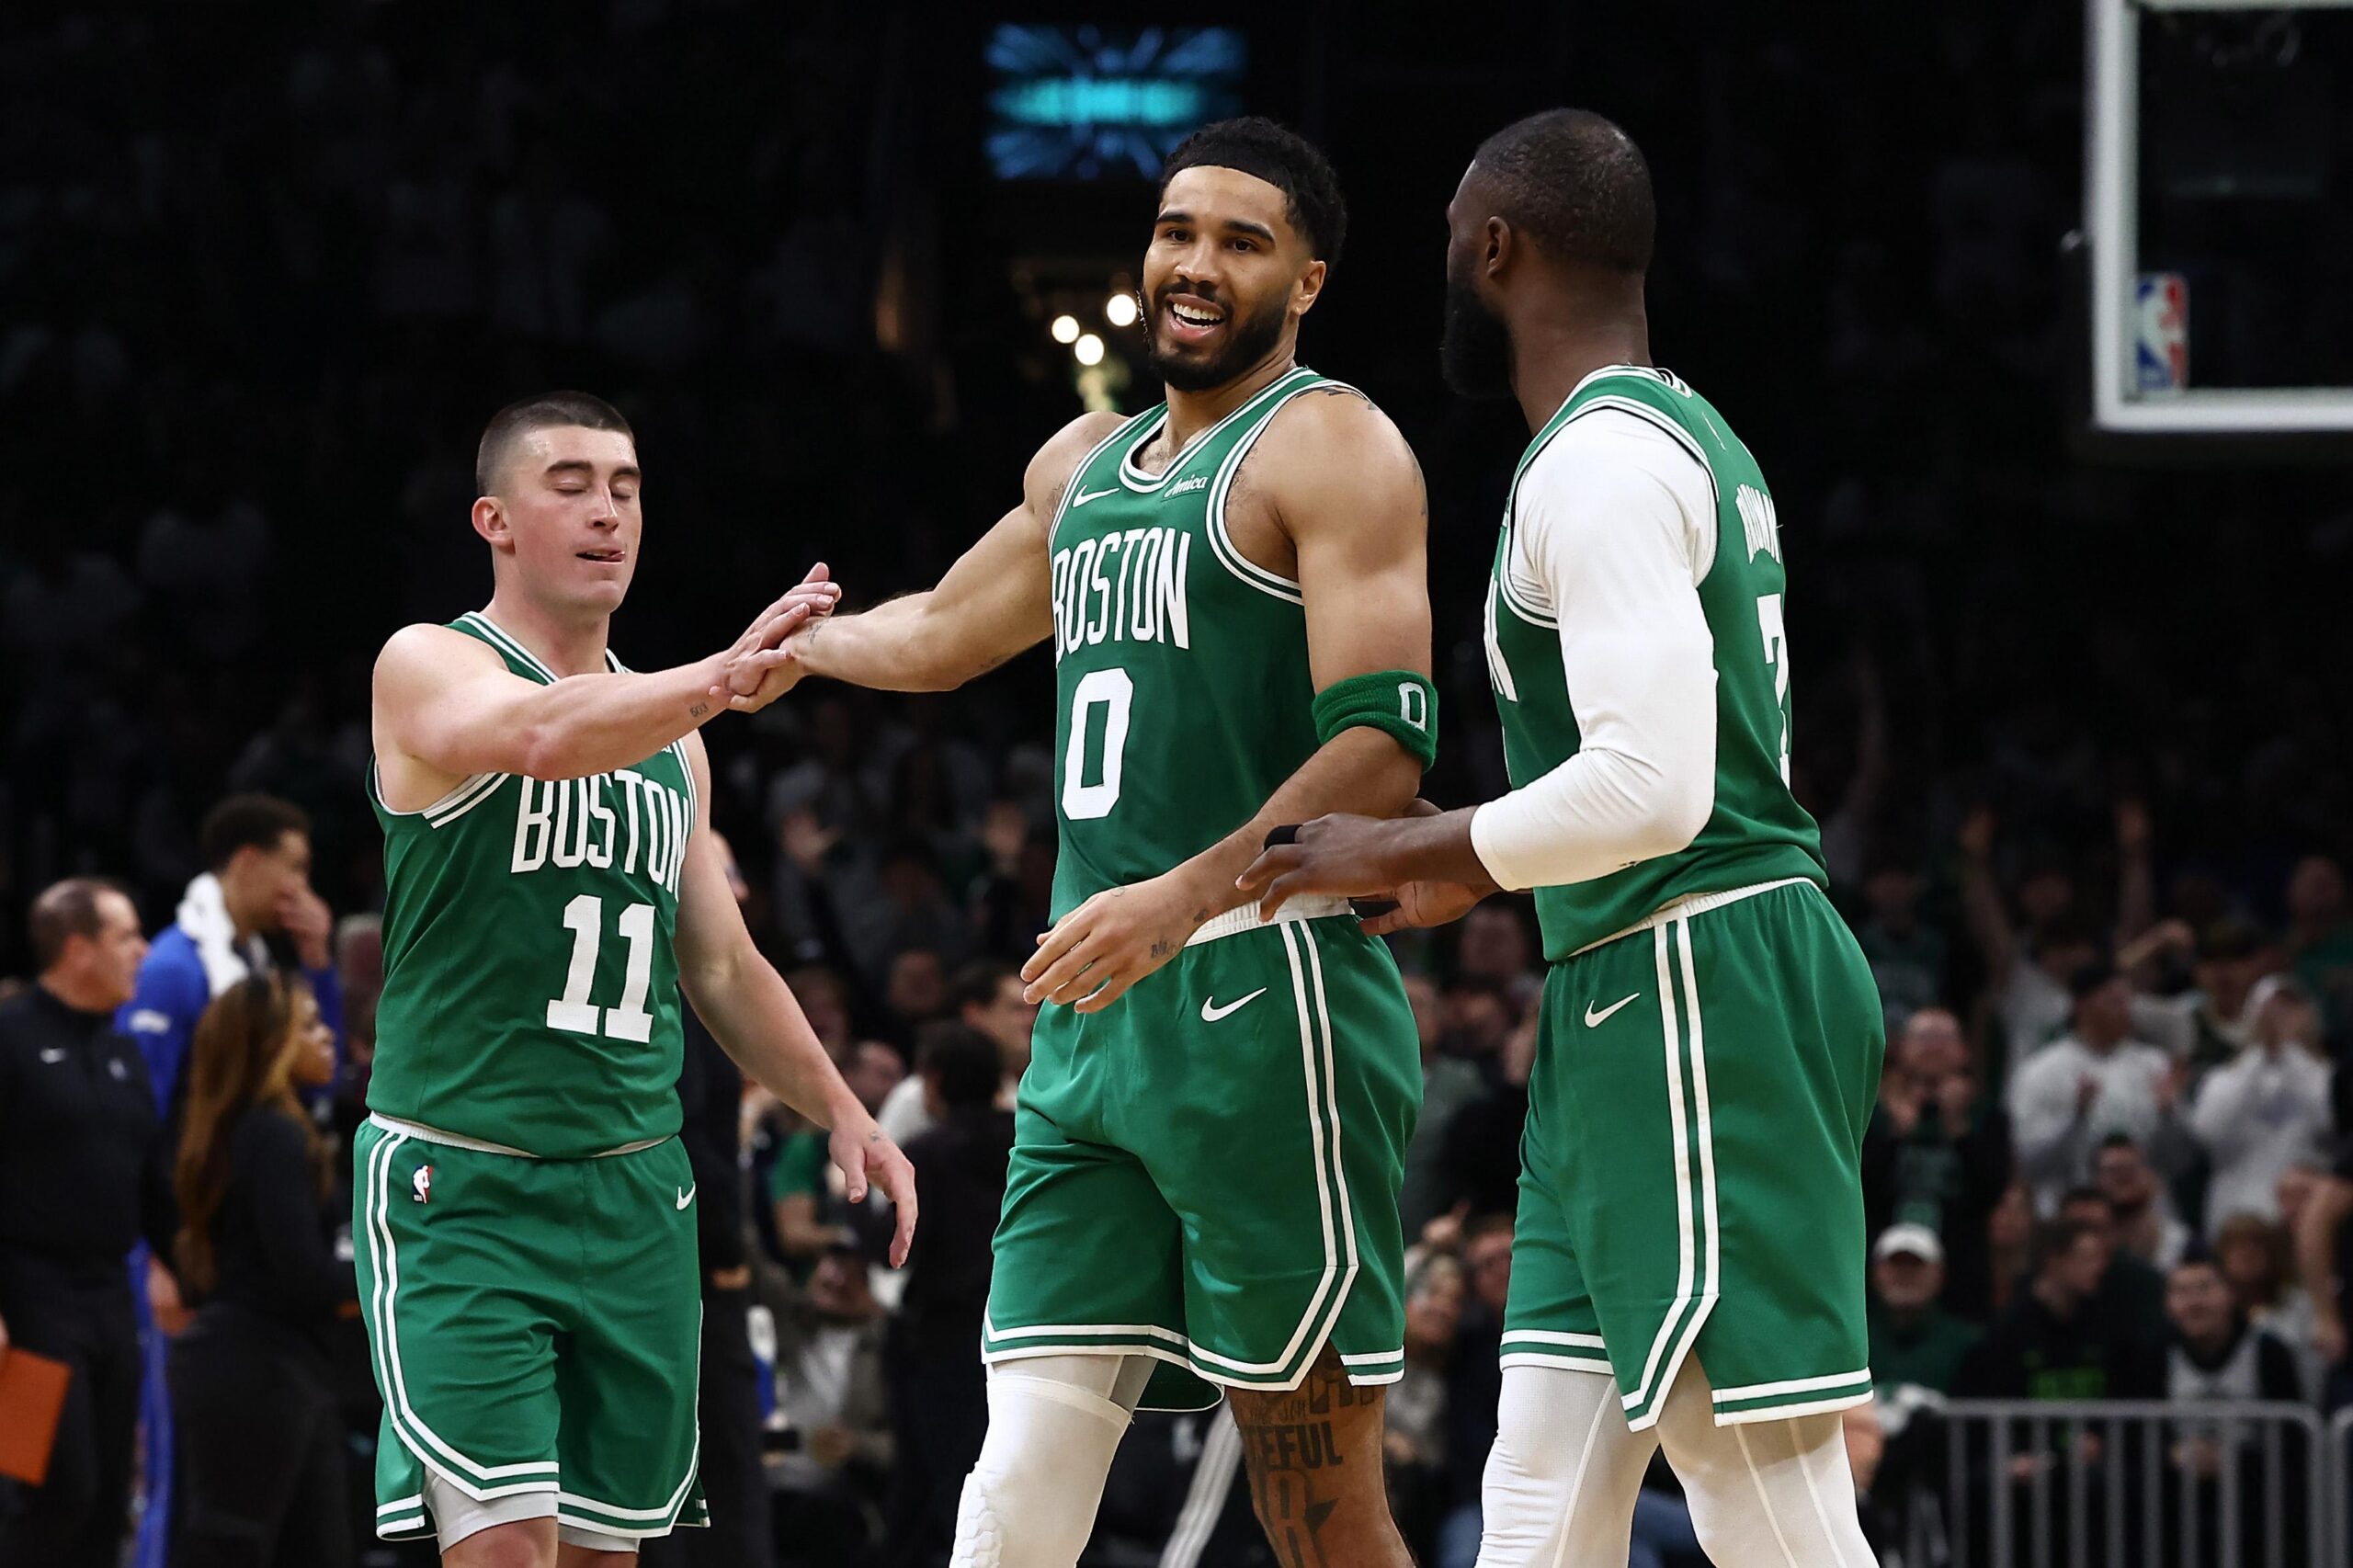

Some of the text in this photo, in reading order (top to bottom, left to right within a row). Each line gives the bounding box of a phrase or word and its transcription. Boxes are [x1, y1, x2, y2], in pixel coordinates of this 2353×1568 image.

[1164, 473, 1209, 498] Amica
[1052, 527, 1191, 669] BOSTON
[1062, 667, 1134, 821] 0
[1398, 682, 1427, 733] 0
[1756, 593, 1790, 791] 7
[510, 768, 689, 903] BOSTON
[546, 893, 656, 1044] 11
